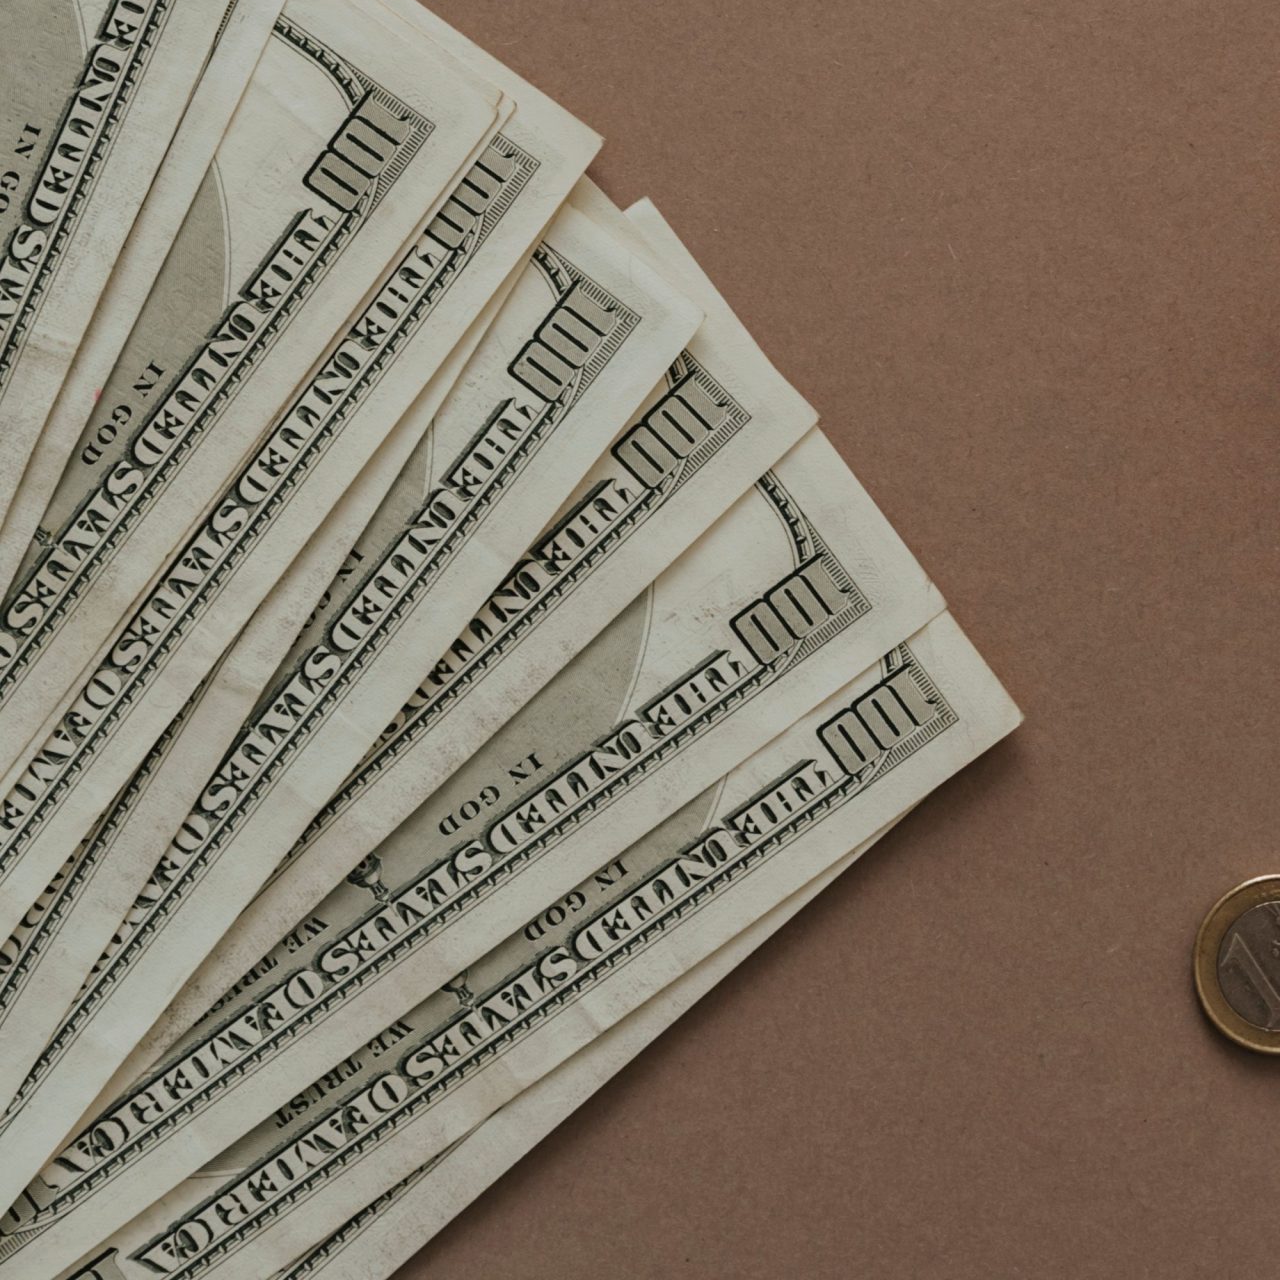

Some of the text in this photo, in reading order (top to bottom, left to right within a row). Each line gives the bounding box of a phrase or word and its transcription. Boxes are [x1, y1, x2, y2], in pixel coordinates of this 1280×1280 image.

[14, 122, 42, 160] IN
[18, 36, 130, 231] UNITED
[348, 241, 443, 351] THE
[504, 278, 623, 407] 100
[0, 90, 415, 641] 100 THE UNITED STATES
[76, 358, 167, 469] IN GOD
[228, 331, 374, 510] UNITED
[441, 394, 539, 506] THE
[608, 371, 730, 492] 100
[100, 491, 255, 680] STATES
[319, 484, 468, 661] UNITED
[530, 472, 637, 578] THE
[726, 548, 861, 669] 100
[189, 640, 347, 827] STATES
[636, 646, 747, 742] THE
[812, 655, 950, 779] 100
[434, 780, 503, 839] GOD
[477, 716, 654, 860] UNITED
[504, 749, 545, 786] IN
[723, 754, 835, 849] THE
[309, 836, 495, 988] STATES
[557, 822, 743, 971] UNITED
[247, 961, 329, 1034] OF
[267, 857, 629, 1130] IN GOD WE TRUST
[394, 945, 577, 1092] STATES
[45, 999, 279, 1185] AMERICA
[332, 1064, 415, 1138] OF
[128, 1102, 362, 1280] AMERICA
